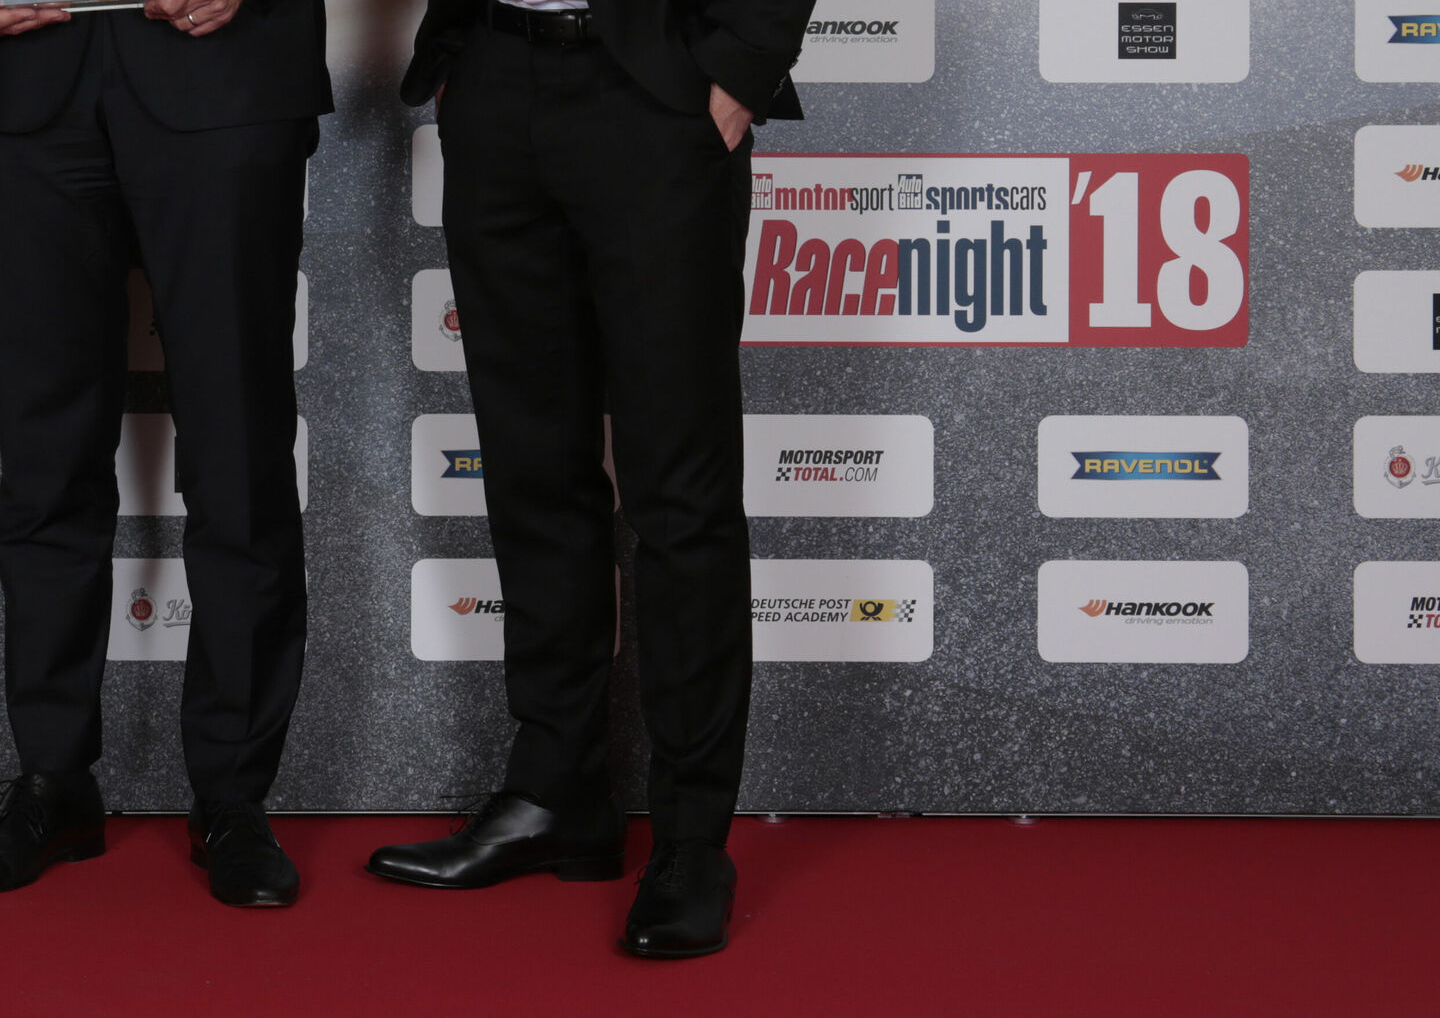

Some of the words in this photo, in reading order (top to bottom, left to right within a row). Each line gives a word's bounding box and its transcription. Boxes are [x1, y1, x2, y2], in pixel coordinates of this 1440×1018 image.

[810, 36, 851, 45] driving
[853, 36, 899, 44] emotion
[1126, 46, 1169, 54] SHOW
[898, 175, 922, 193] Auto
[775, 183, 894, 215] motorsport
[899, 193, 921, 209] Bild
[925, 183, 1047, 215] sportscars
[749, 219, 1048, 333] Racenight
[779, 450, 884, 465] MOTORSPORT
[1084, 458, 1208, 474] RAVENOL
[793, 467, 878, 482] TOTAL.COM
[751, 599, 816, 610] DEUTSCHE
[819, 599, 851, 610] POST
[752, 612, 782, 622] PEED
[784, 612, 849, 622] ACADEMY
